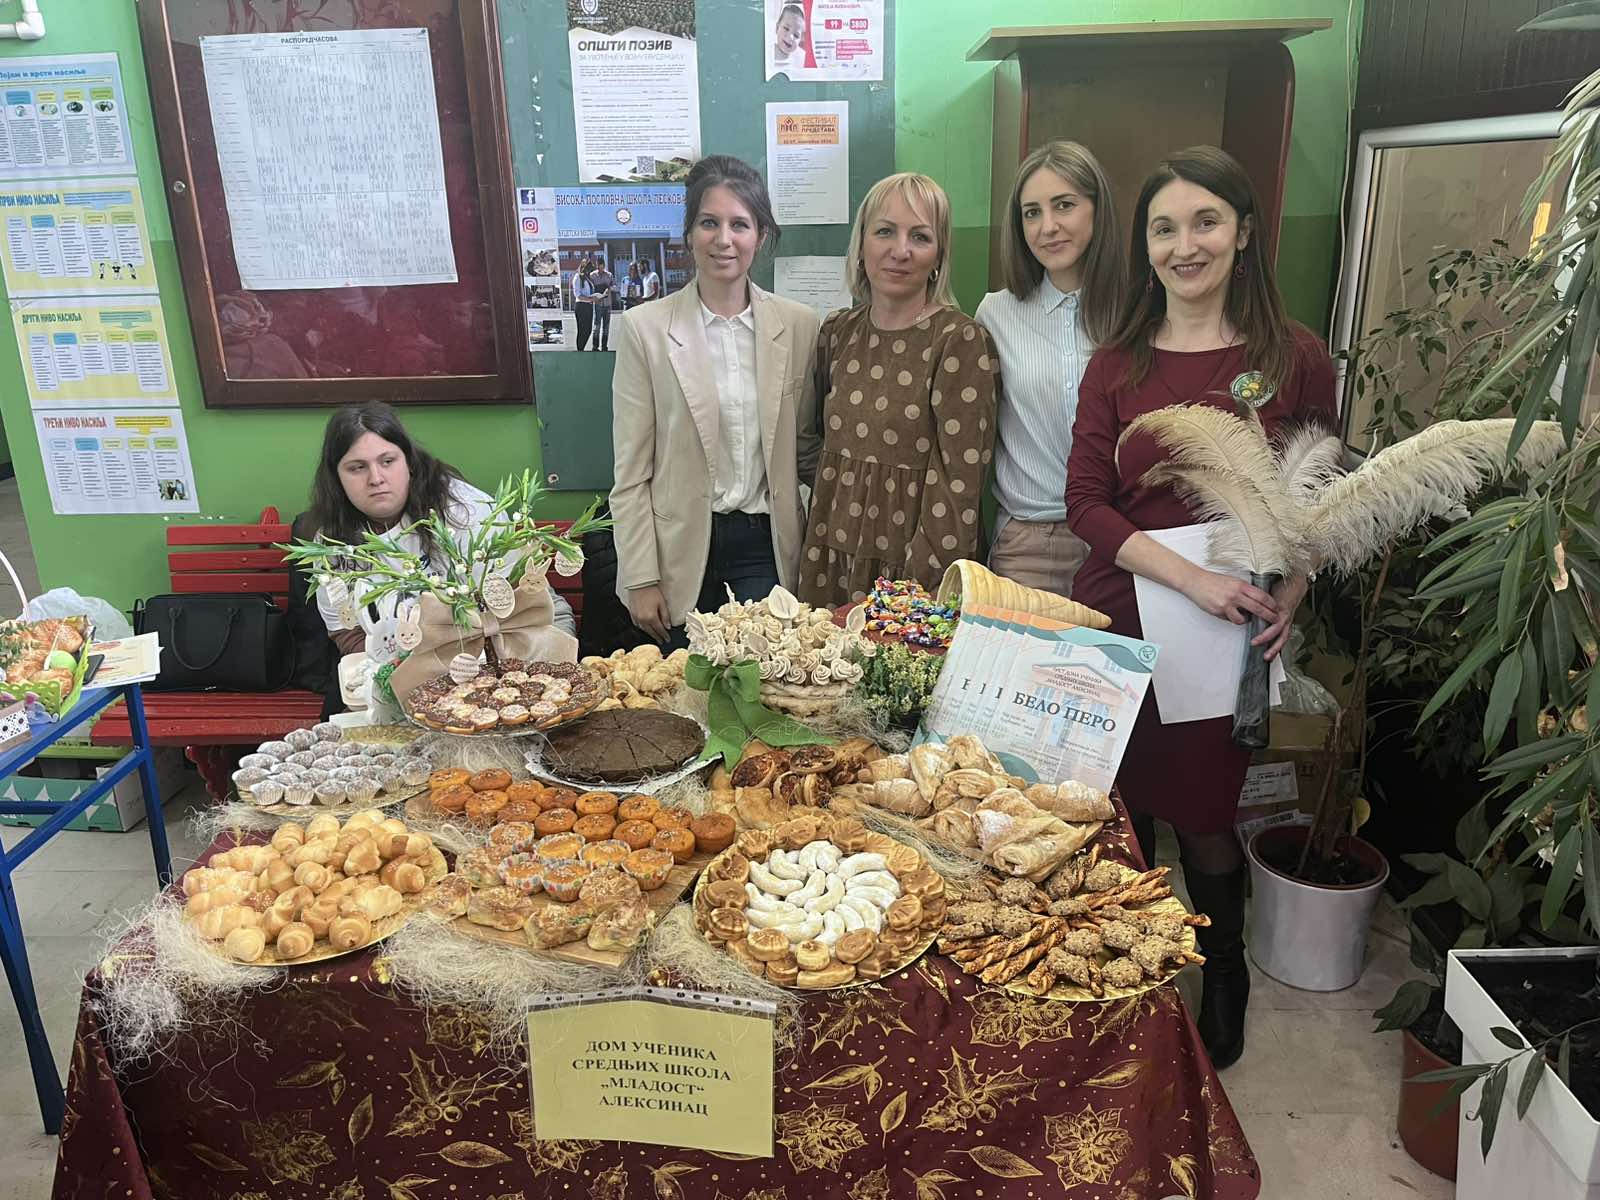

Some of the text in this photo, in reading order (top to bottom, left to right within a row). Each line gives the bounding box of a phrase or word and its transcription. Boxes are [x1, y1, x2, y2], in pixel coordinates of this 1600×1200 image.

[577, 40, 672, 51] ОПШТИ ПОЗИВ
[556, 194, 584, 205] ВИСОКА
[586, 193, 624, 205] ПОСЛОВНА
[626, 194, 652, 204] ШКОЛА
[22, 312, 82, 324] ДРУГИ НИВО НАСИЉА
[43, 417, 64, 428] ТРЕЋИ
[64, 416, 80, 428] НИВО
[81, 416, 107, 428] НАСИЉА
[1013, 691, 1060, 715] БЕЛО
[1063, 706, 1116, 732] ПЕРО
[586, 1040, 717, 1061] ДОМ УЧЕНИКА
[572, 1059, 731, 1081] СРЕДЊИХ ШКОЛА
[599, 1095, 709, 1116] АЛЕКСИНАЦ
